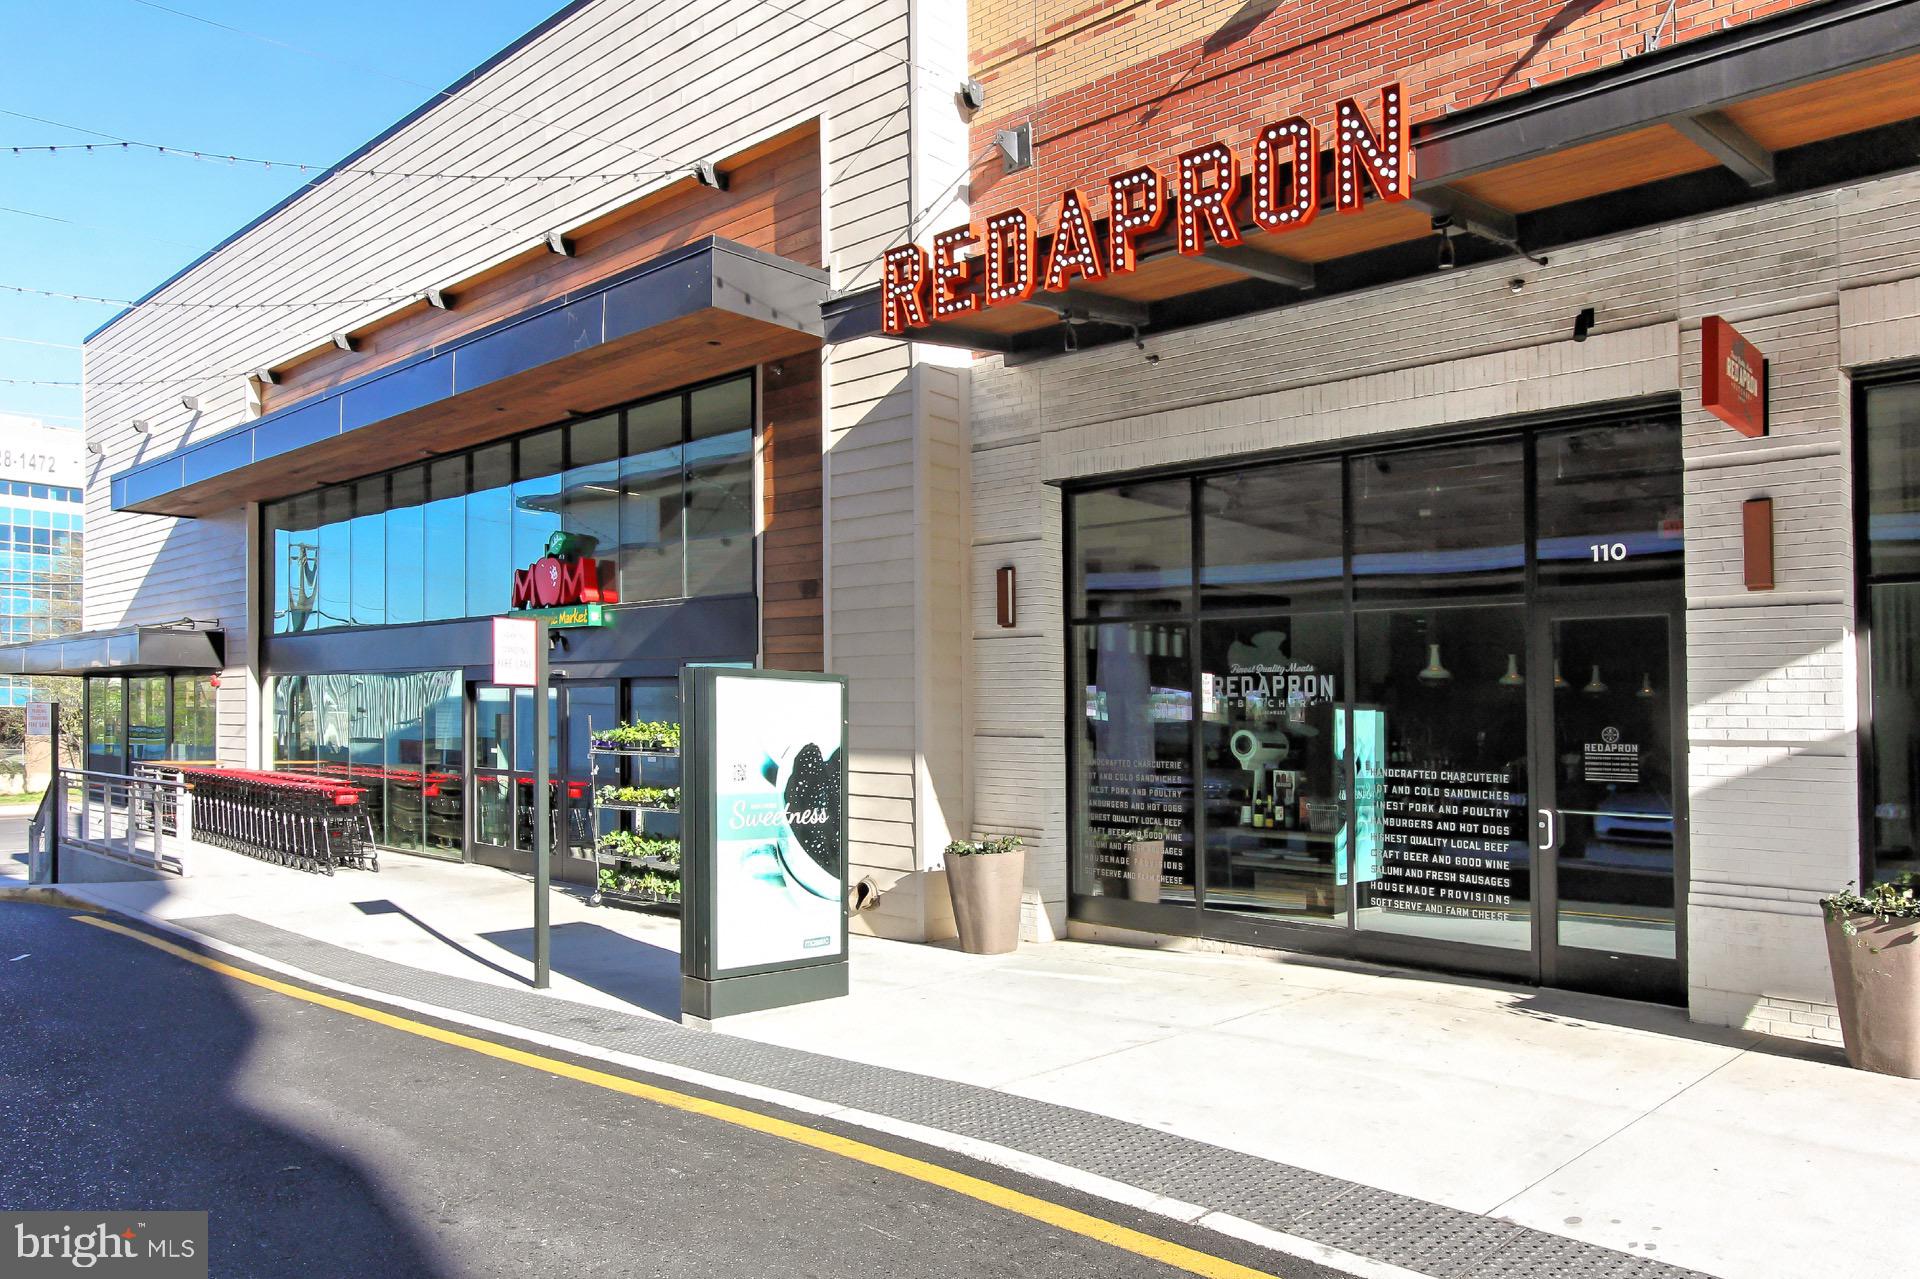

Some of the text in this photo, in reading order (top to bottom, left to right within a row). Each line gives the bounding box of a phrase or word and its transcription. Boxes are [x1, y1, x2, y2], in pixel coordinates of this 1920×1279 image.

[1590, 542, 1627, 562] 110
[559, 608, 588, 624] Market
[1256, 663, 1286, 675] Quality
[1286, 662, 1315, 673] Meats
[1133, 760, 1182, 769] CHARCUTERIE
[1115, 773, 1134, 782] COLD
[1135, 774, 1182, 784] SANDWICHES
[1371, 768, 1510, 784] HANDCRAFTED CHARCUTERIE
[1087, 785, 1183, 799] INEST PORK AND POULTRY
[1372, 784, 1388, 794] OT
[1392, 785, 1410, 795] AND
[1414, 786, 1440, 797] COLD
[1444, 788, 1510, 801] SANDWICHES
[1087, 799, 1183, 813] AMBURGERS AND HOT DOGS
[1372, 801, 1510, 818] INEST PORK AND POULTRY
[729, 800, 829, 830] Sweetness
[1087, 812, 1183, 828] IGHEST QUALITY LOCAL BEEF
[1087, 826, 1105, 835] RAFT
[1107, 827, 1126, 837] BEER
[1144, 831, 1163, 840] GOOD
[1165, 833, 1183, 842] WINE
[1436, 821, 1456, 832] AND
[1459, 823, 1479, 834] HOT
[1482, 825, 1510, 836] DOGS
[1109, 842, 1122, 851] AND
[1148, 845, 1183, 857] SAGES
[1371, 833, 1510, 853] HIGHEST QUALITY LOCAL BEEF
[1134, 857, 1183, 870] POIONS
[1371, 849, 1510, 871] CRAFT BEER AND GOOD WINE
[1123, 871, 1136, 880] AND
[1156, 874, 1183, 885] CHEESE
[1371, 864, 1510, 888] SALUMI AND FRESH SAUSAGES
[1370, 881, 1510, 905] HOUSEMADE PROVISIONS
[1425, 903, 1443, 914] AND
[1446, 906, 1469, 917] FARM
[1472, 909, 1510, 922] CHEESE
